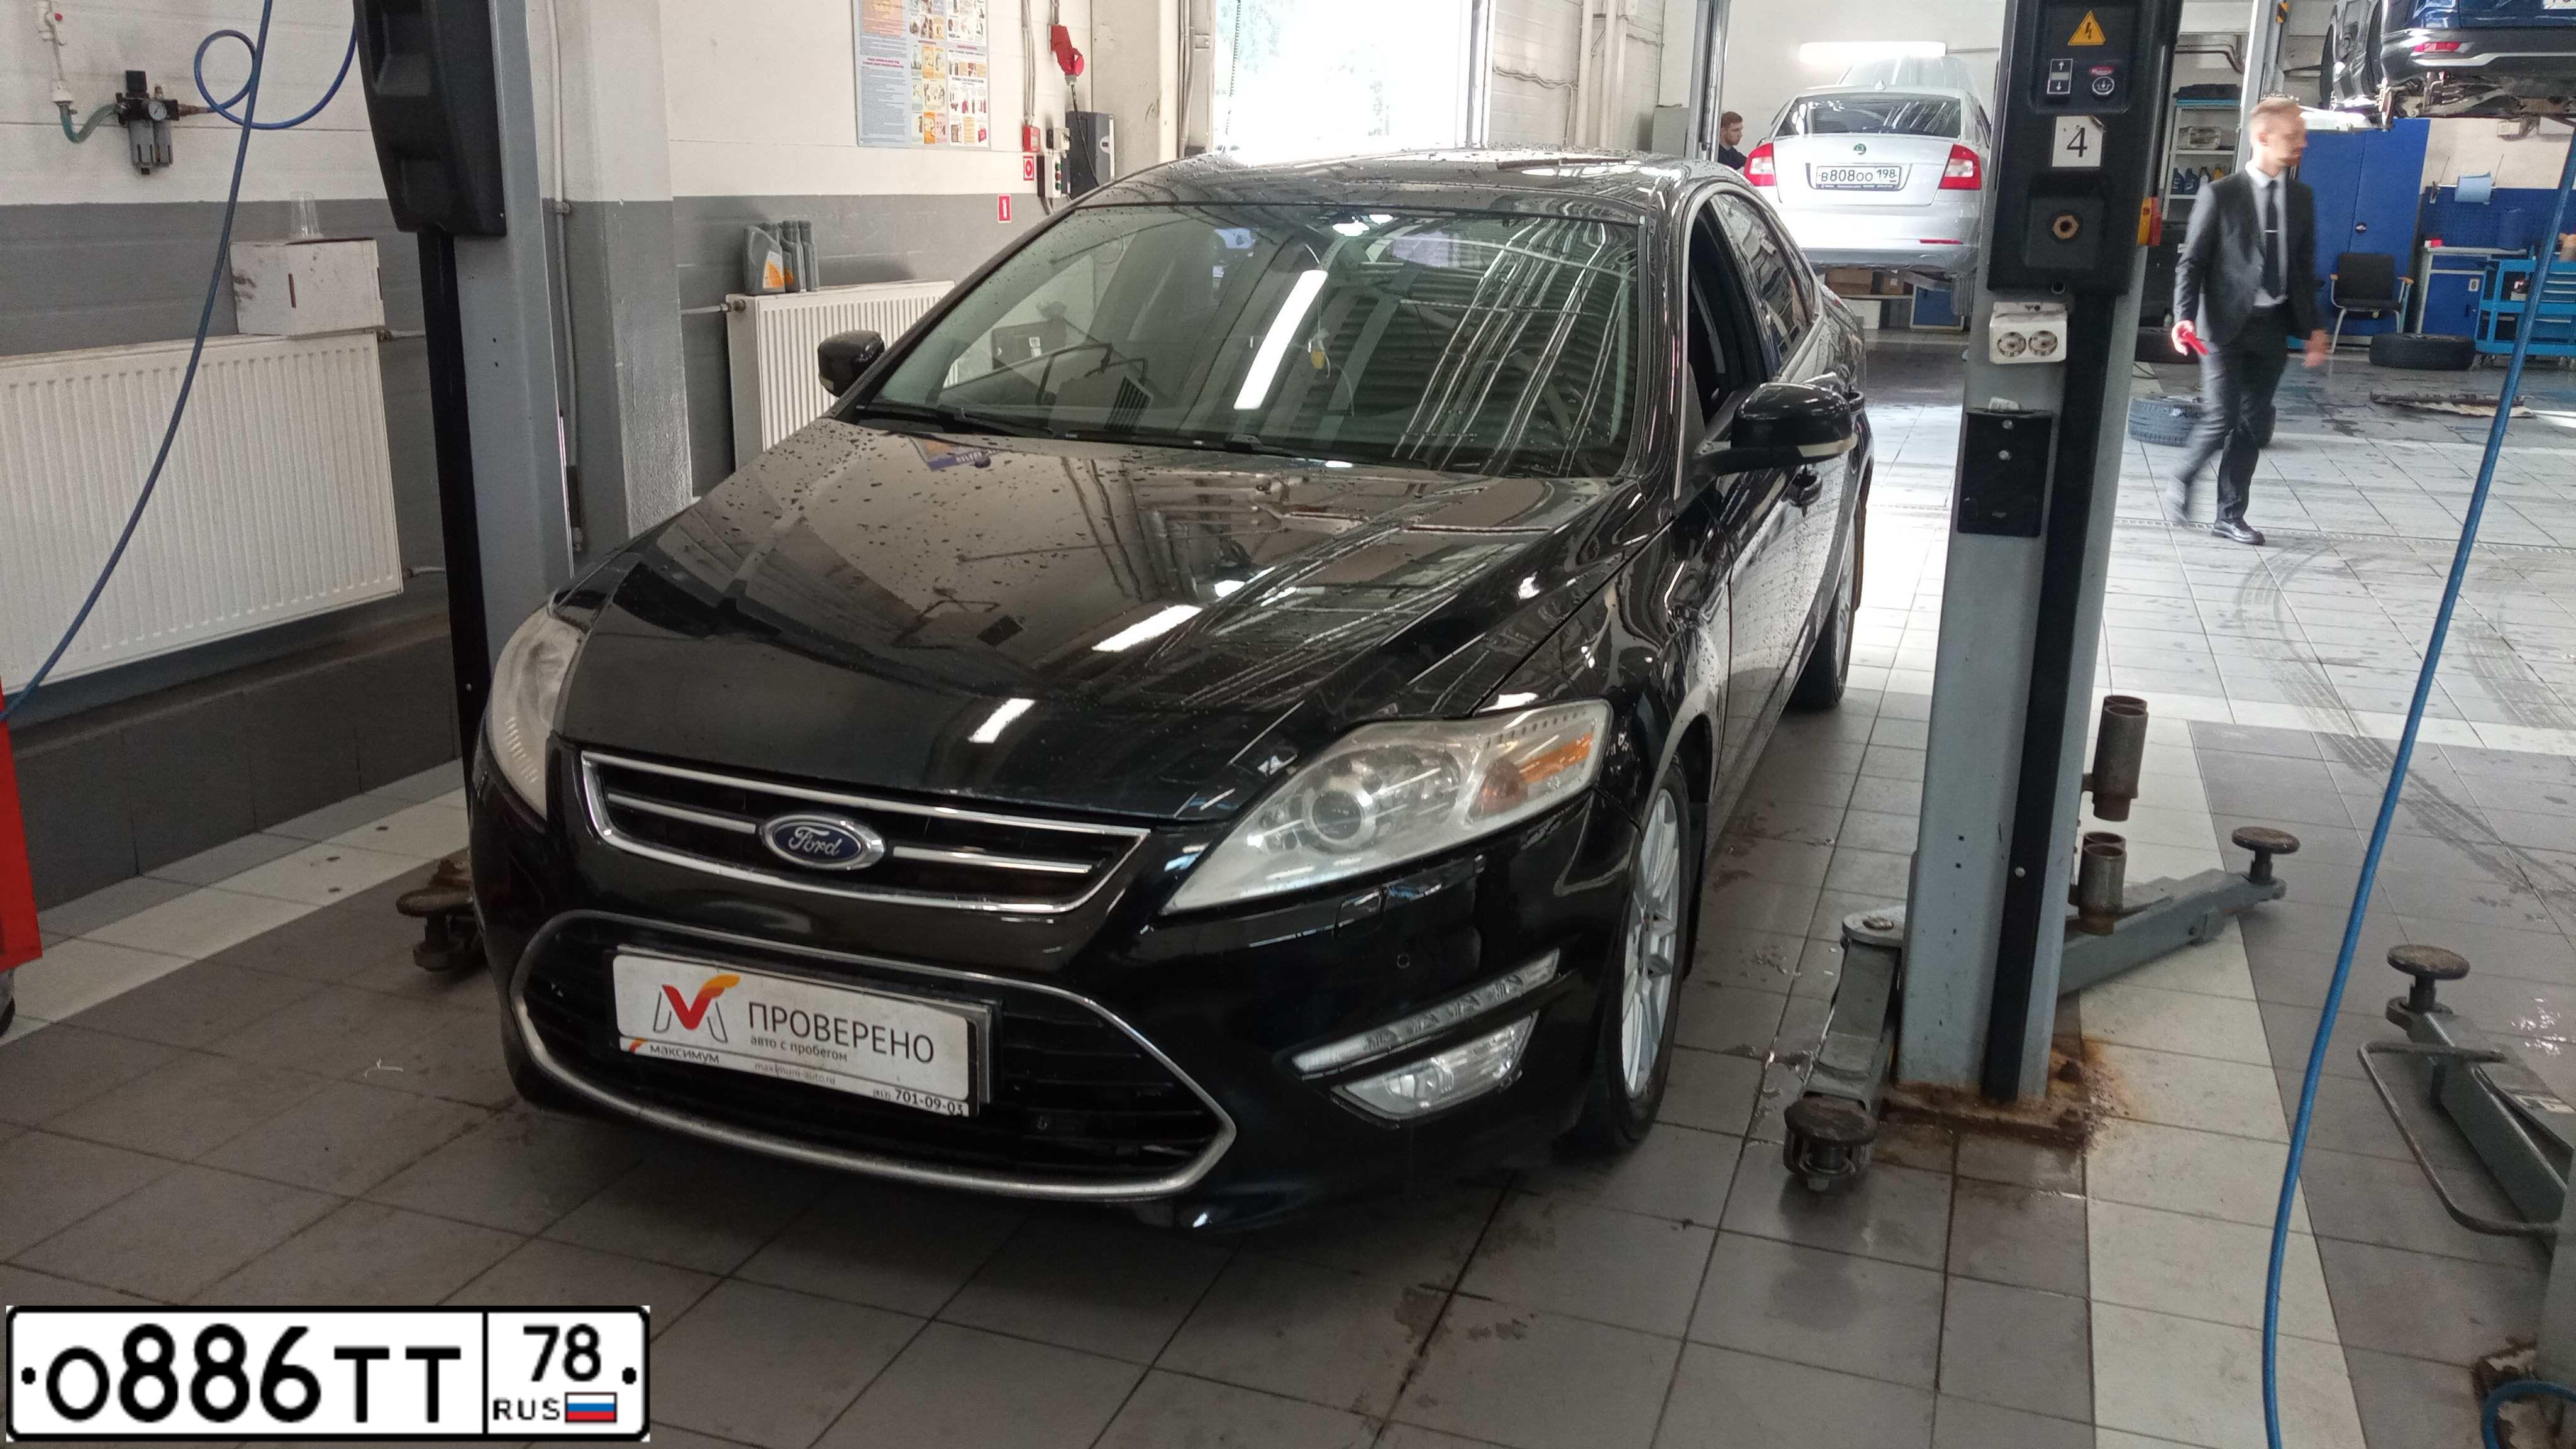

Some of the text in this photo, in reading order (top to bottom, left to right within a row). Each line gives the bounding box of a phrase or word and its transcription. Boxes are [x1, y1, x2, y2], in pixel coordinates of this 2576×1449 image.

[2067, 127, 2088, 157] 4
[1877, 169, 1896, 179] 198
[789, 826, 842, 856] Ford
[748, 1001, 935, 1063] ПРОВЕРЕНО
[650, 1044, 719, 1065] максимум
[751, 1035, 848, 1063] авто с пробегом
[894, 1088, 963, 1116] 701-09-03
